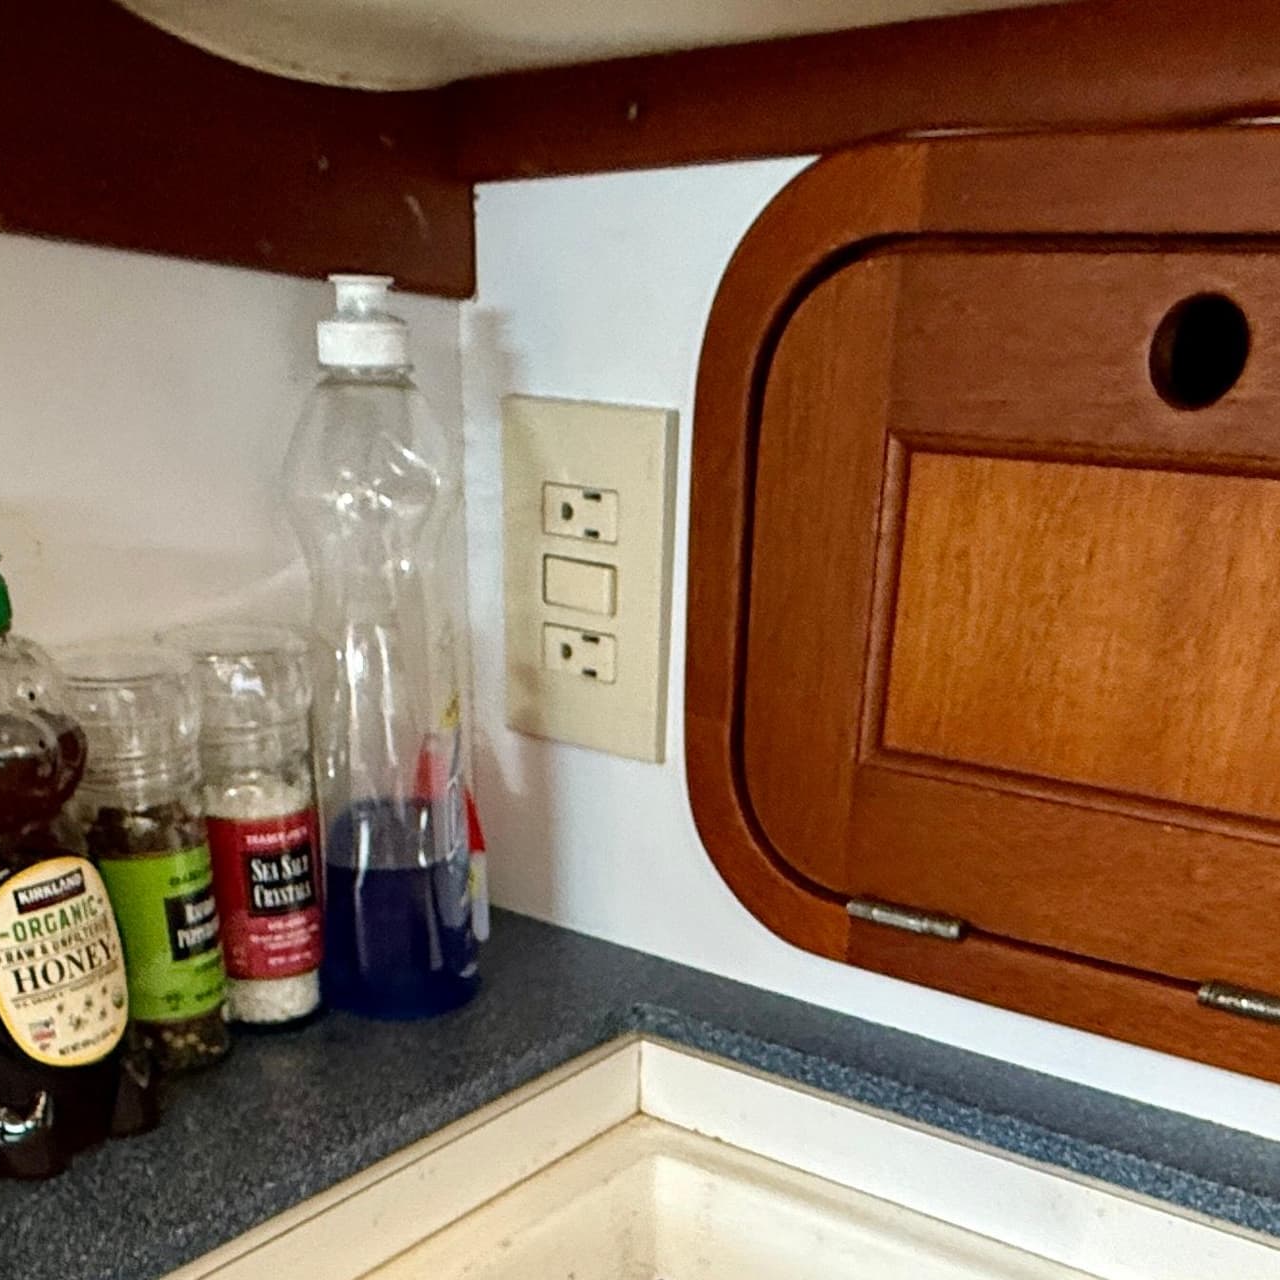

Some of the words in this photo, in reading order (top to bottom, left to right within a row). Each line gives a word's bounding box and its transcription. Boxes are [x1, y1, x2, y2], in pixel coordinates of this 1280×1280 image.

[16, 872, 84, 907] KIRKLAND
[12, 896, 99, 943] ORGANIC
[5, 944, 36, 965] RAW
[10, 937, 114, 994] HONEY
